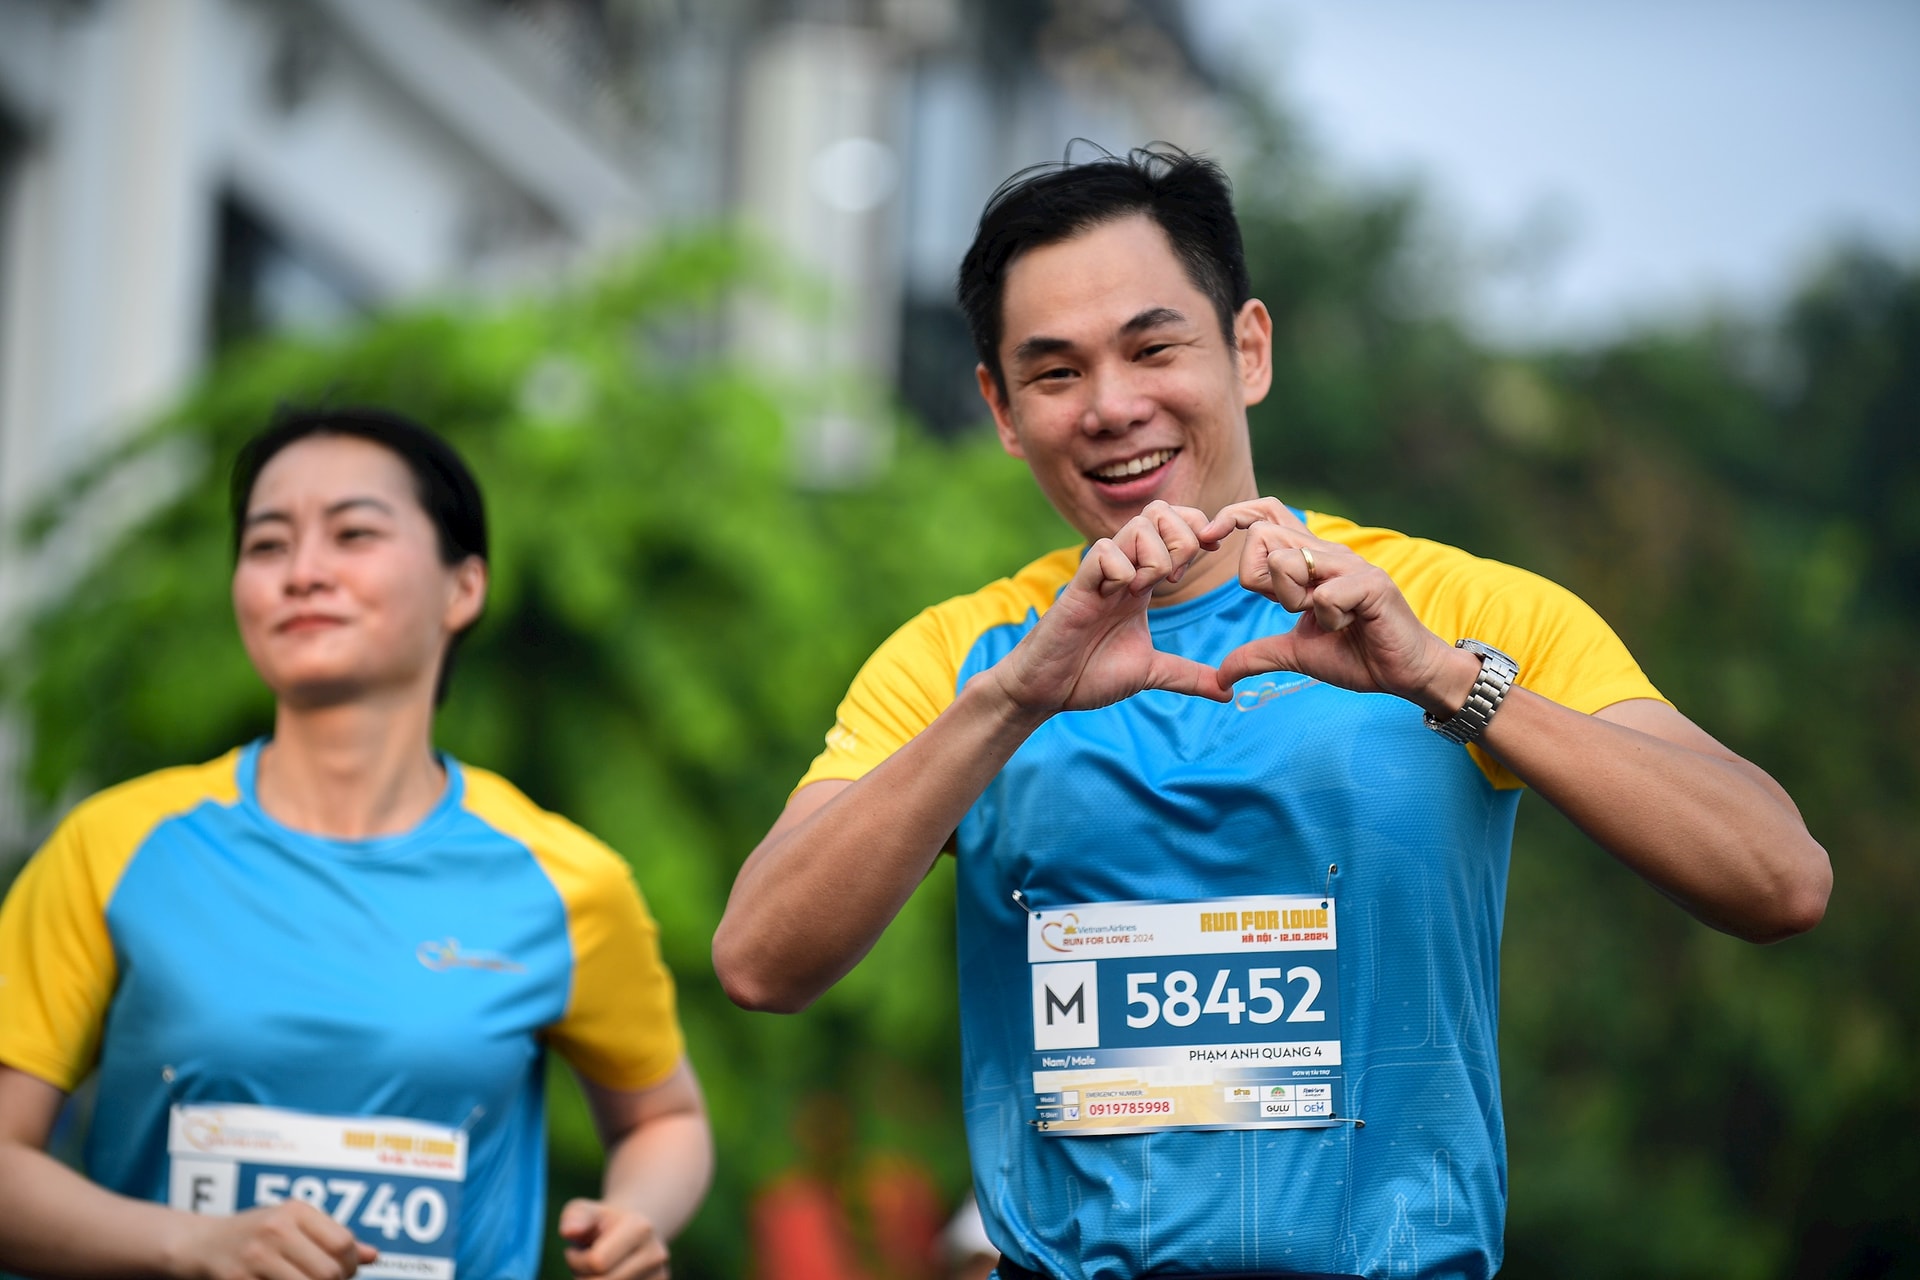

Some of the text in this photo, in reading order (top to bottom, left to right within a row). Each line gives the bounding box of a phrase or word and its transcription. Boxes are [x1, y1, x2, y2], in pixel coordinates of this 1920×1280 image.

[1201, 912, 1238, 932] RUN
[1241, 910, 1279, 930] FOR
[1063, 934, 1154, 946] RUN FOR LOVE 2024
[1280, 932, 1329, 942] 12.10.2024
[1045, 982, 1085, 1026] M
[1127, 966, 1326, 1029] 58452
[1189, 1046, 1322, 1063] PHẠM ANH QUANG 4
[1089, 1101, 1170, 1116] 0919785998
[1266, 1104, 1290, 1113] GULU
